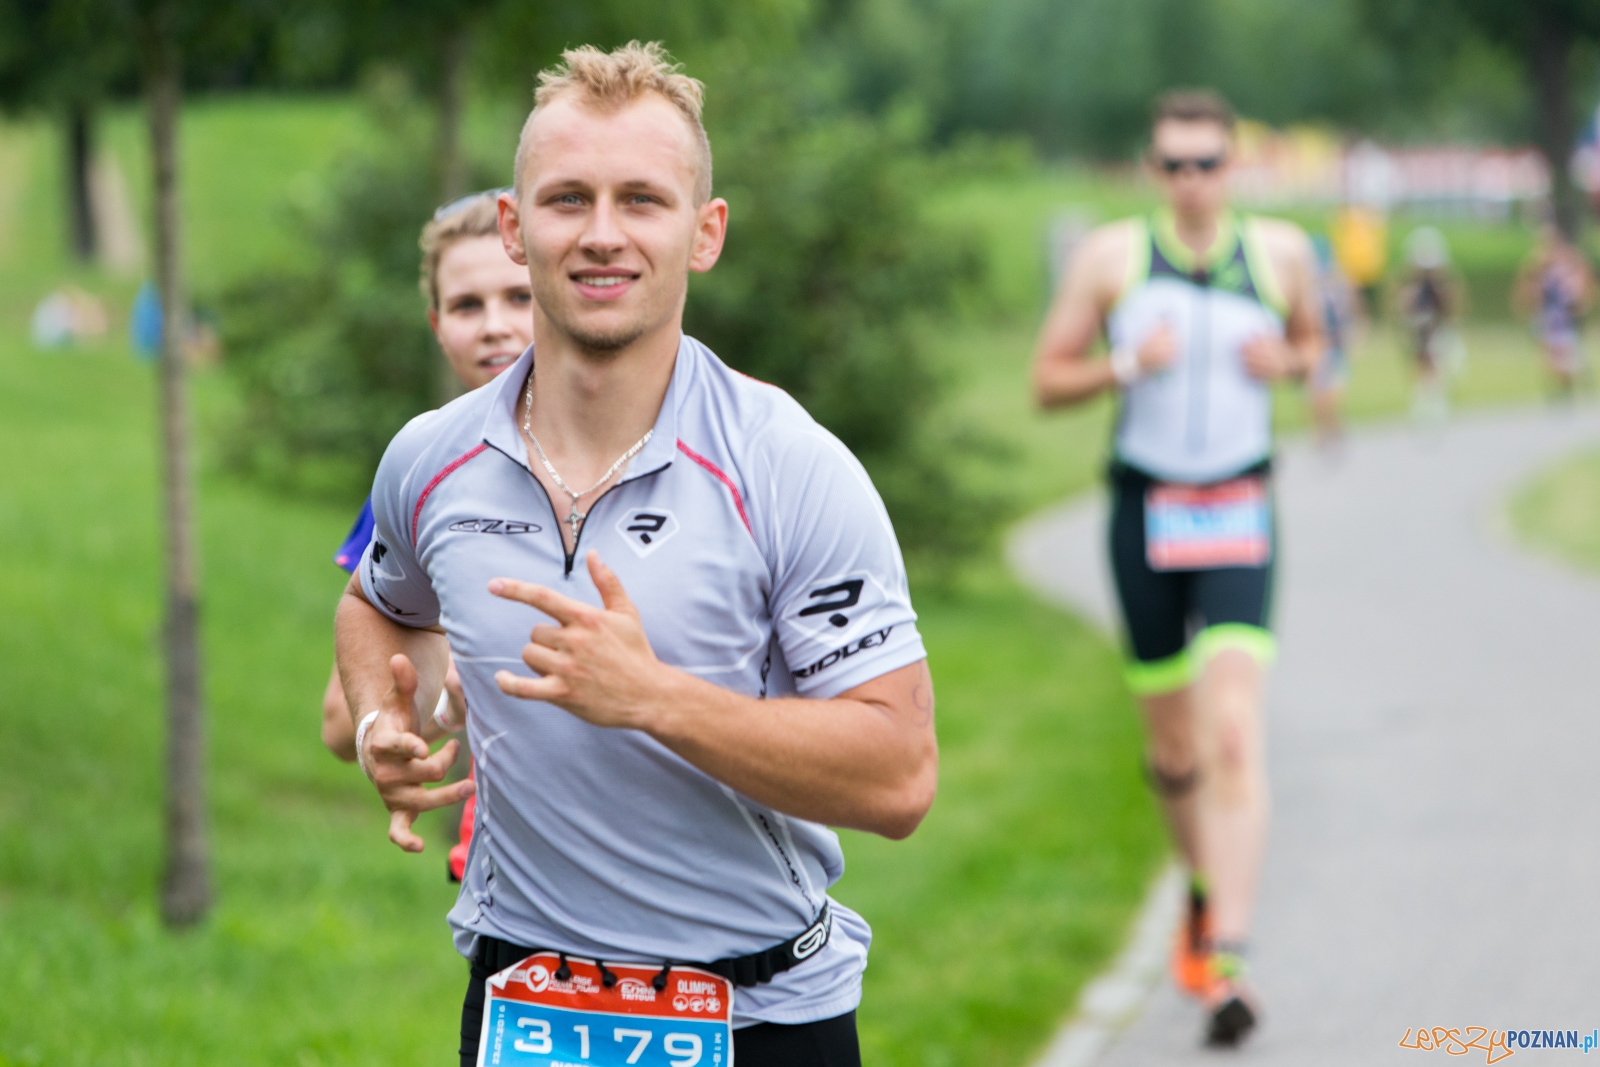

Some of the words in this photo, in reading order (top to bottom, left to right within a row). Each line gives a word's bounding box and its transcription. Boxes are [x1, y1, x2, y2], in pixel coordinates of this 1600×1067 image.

[791, 625, 894, 678] RIDLEY
[677, 979, 717, 996] OLIMPIC
[514, 1016, 703, 1067] 3179
